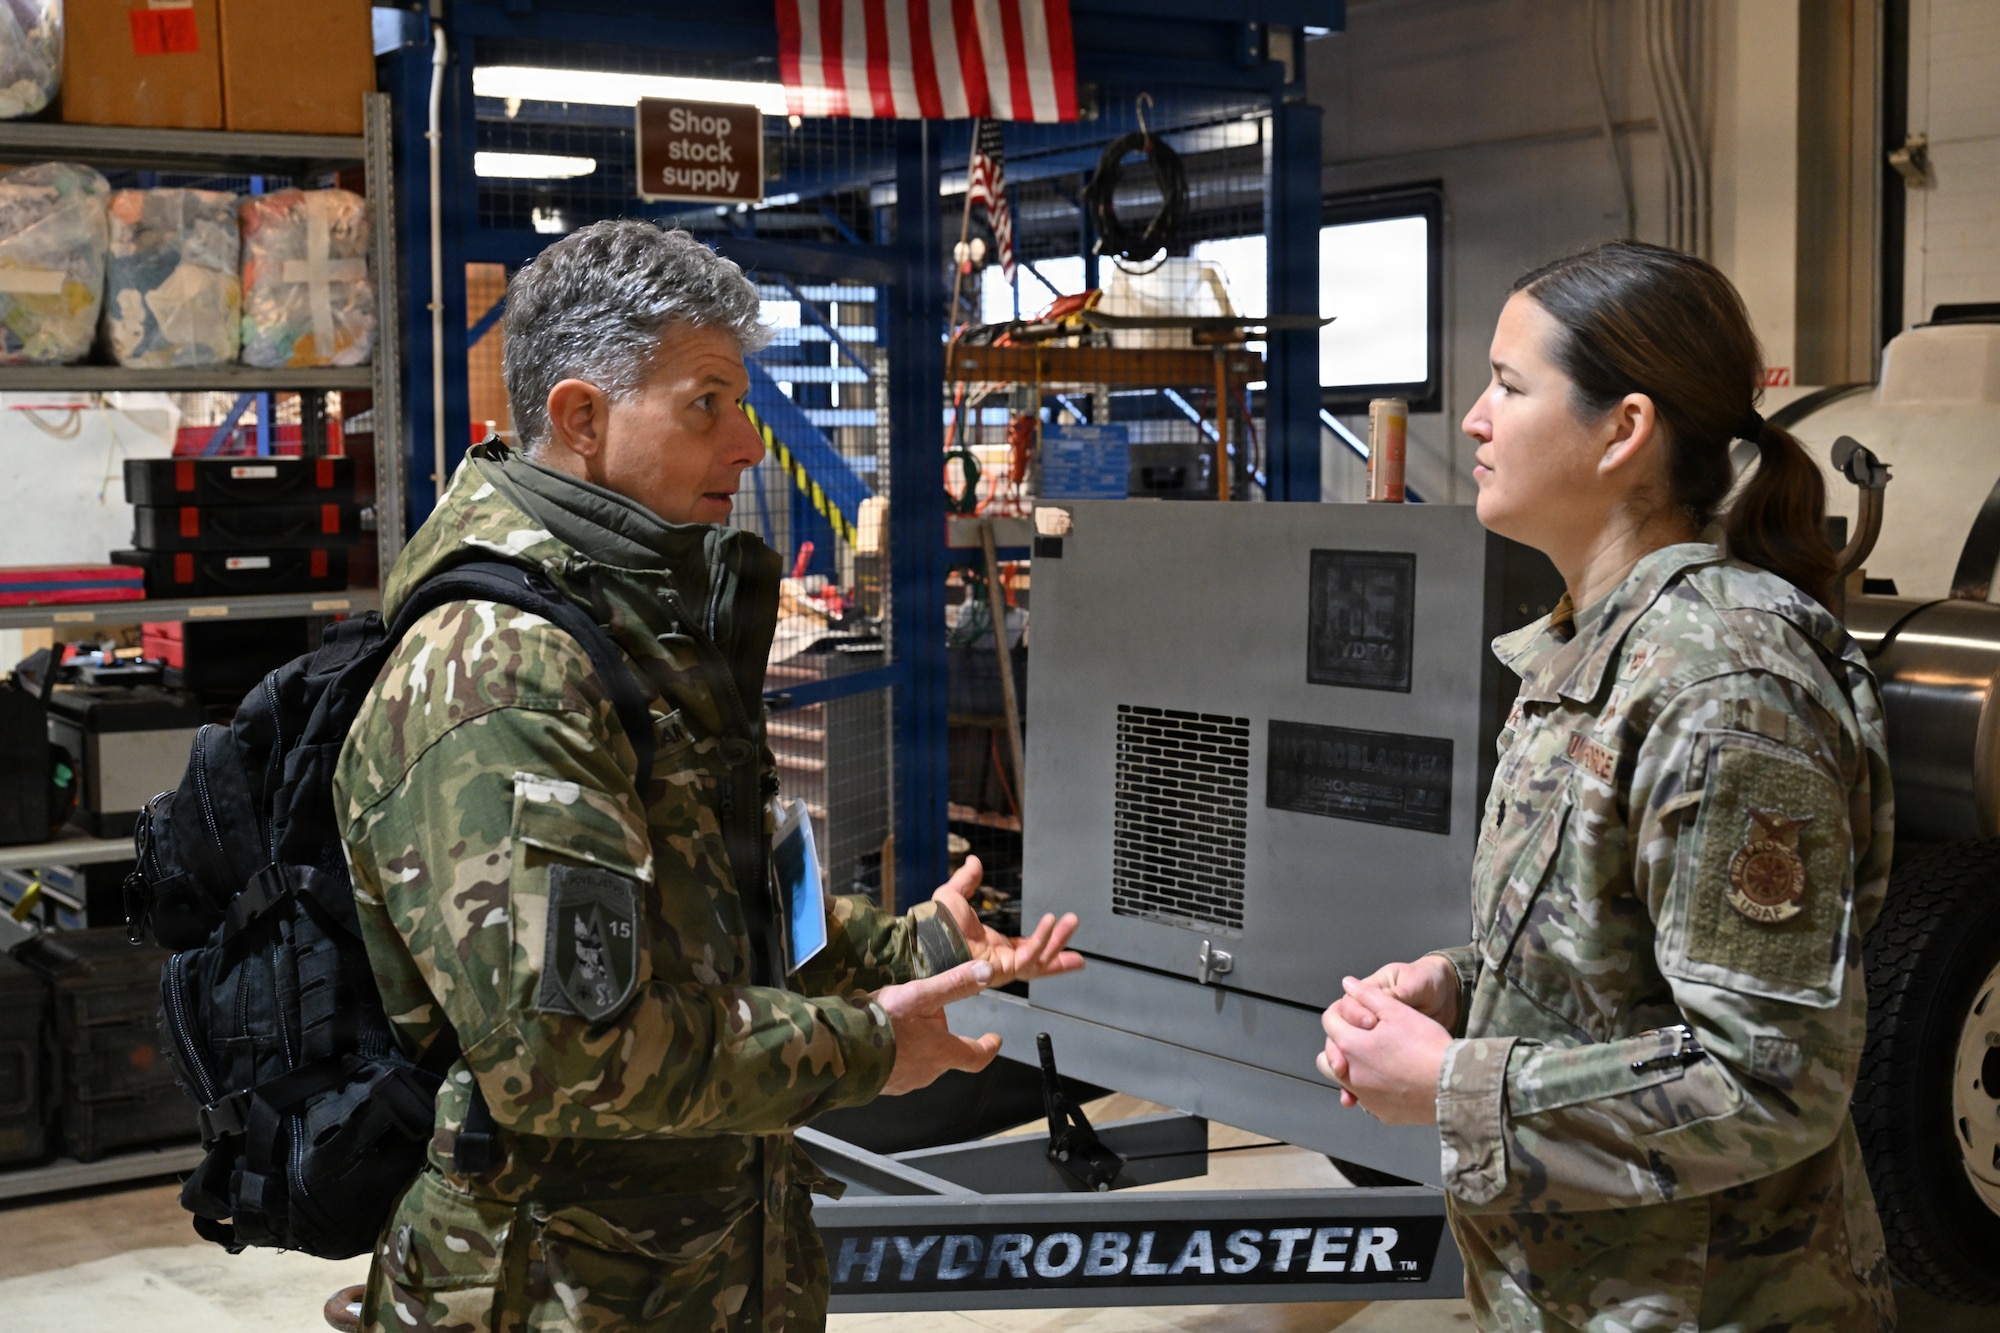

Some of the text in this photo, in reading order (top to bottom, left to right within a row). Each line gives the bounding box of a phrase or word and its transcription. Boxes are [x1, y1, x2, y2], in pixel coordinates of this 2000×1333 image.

[669, 107, 732, 138] Shop
[668, 138, 734, 163] stock
[662, 165, 740, 193] supply
[1741, 899, 1783, 919] USAF
[609, 920, 631, 938] 15
[834, 1226, 1400, 1282] HYDROBLASTER
